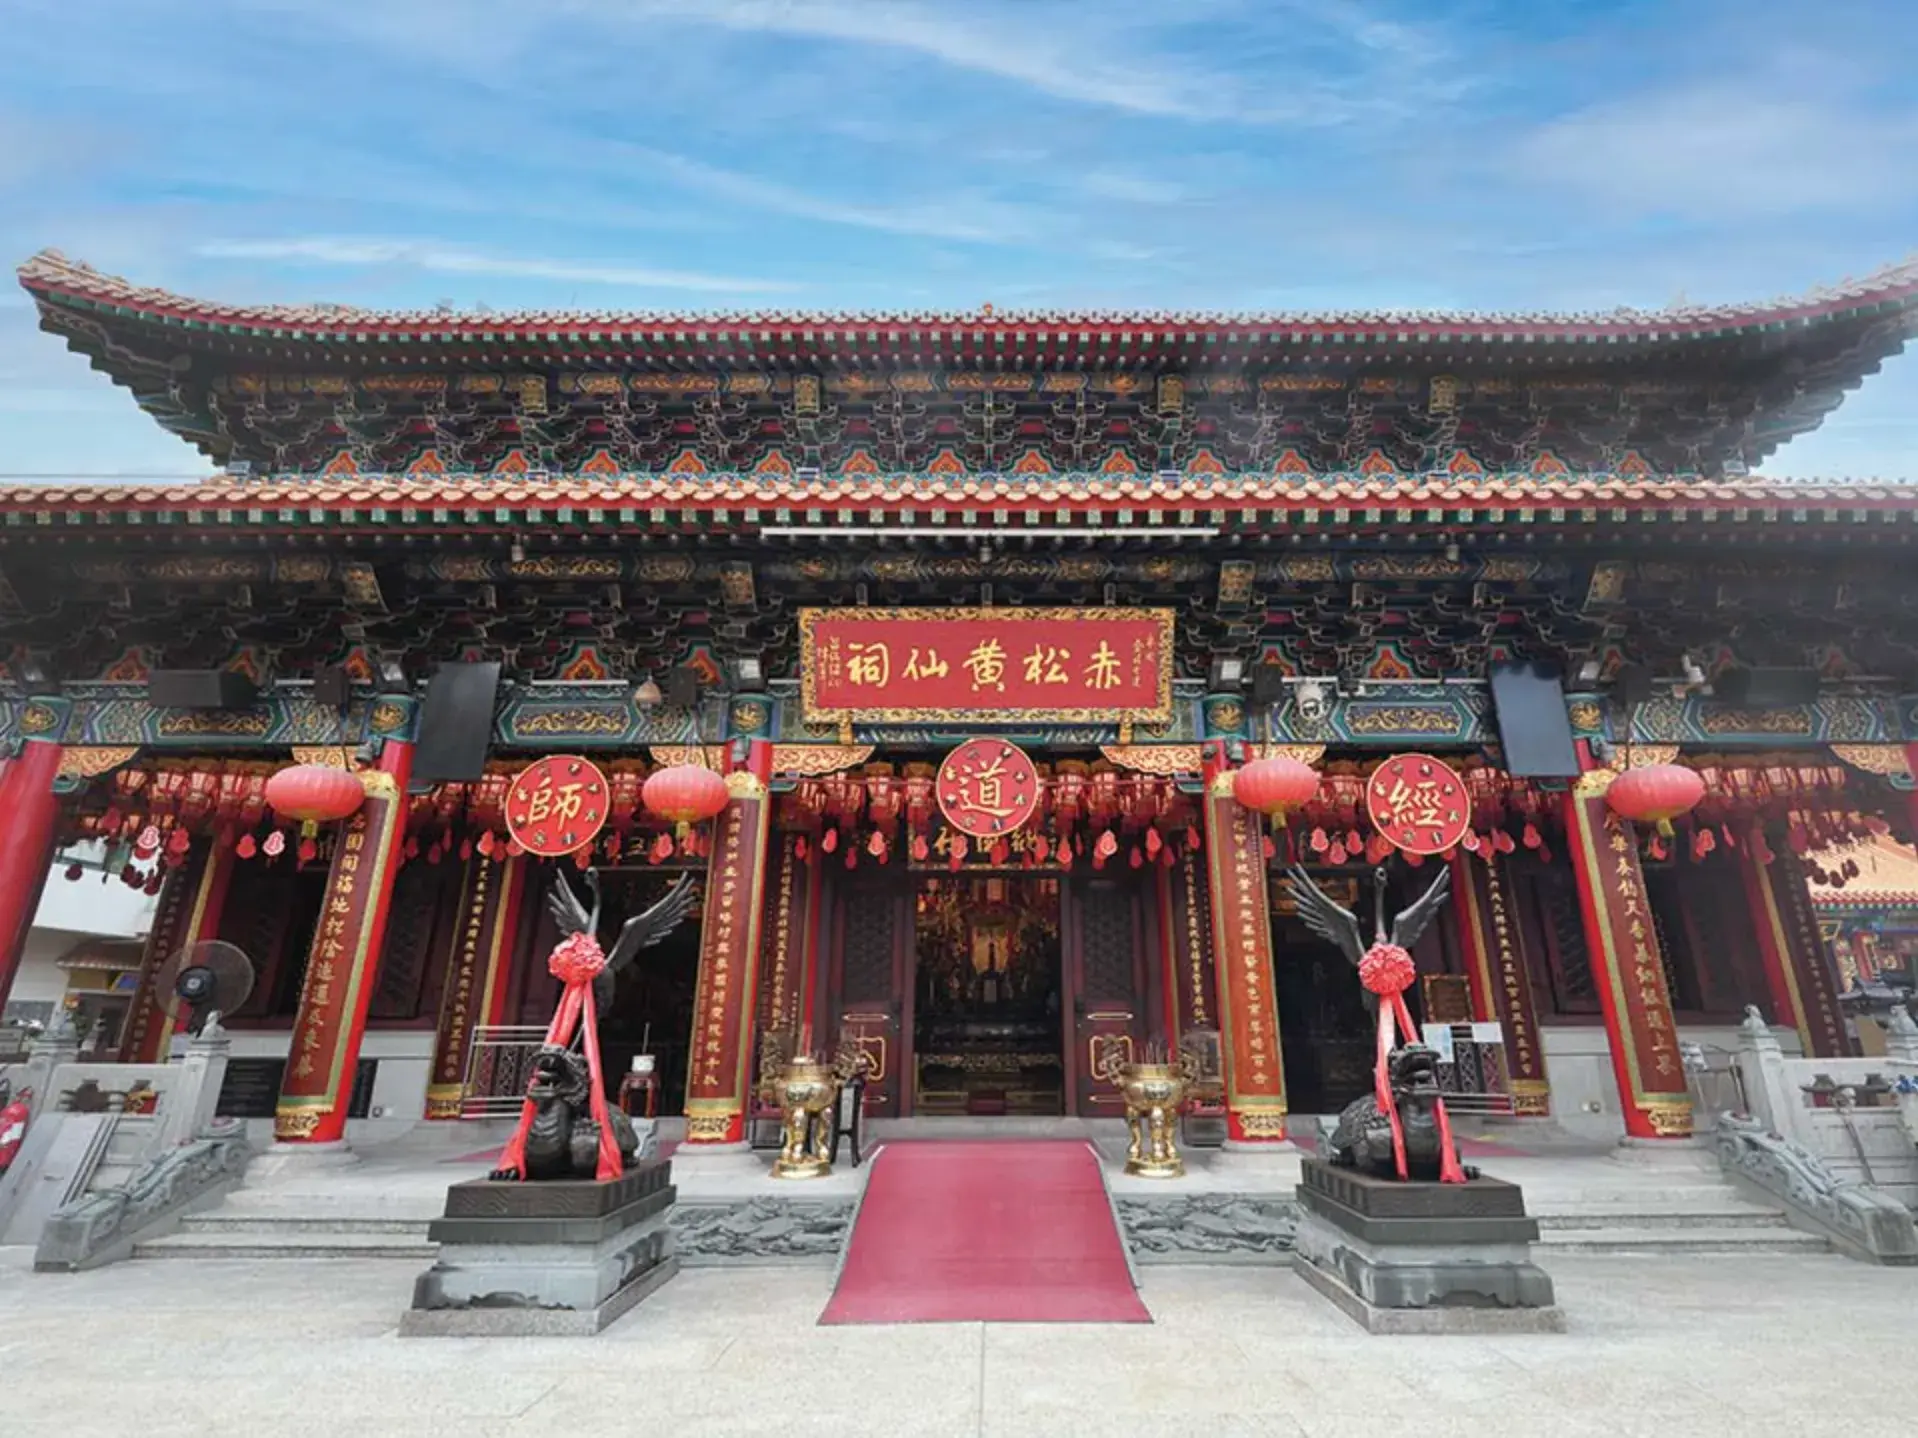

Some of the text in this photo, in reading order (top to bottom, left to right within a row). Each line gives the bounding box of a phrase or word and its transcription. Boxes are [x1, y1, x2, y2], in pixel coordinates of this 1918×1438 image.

[527, 776, 584, 832] 師
[958, 756, 1016, 817] 道
[1388, 777, 1445, 829] 經
